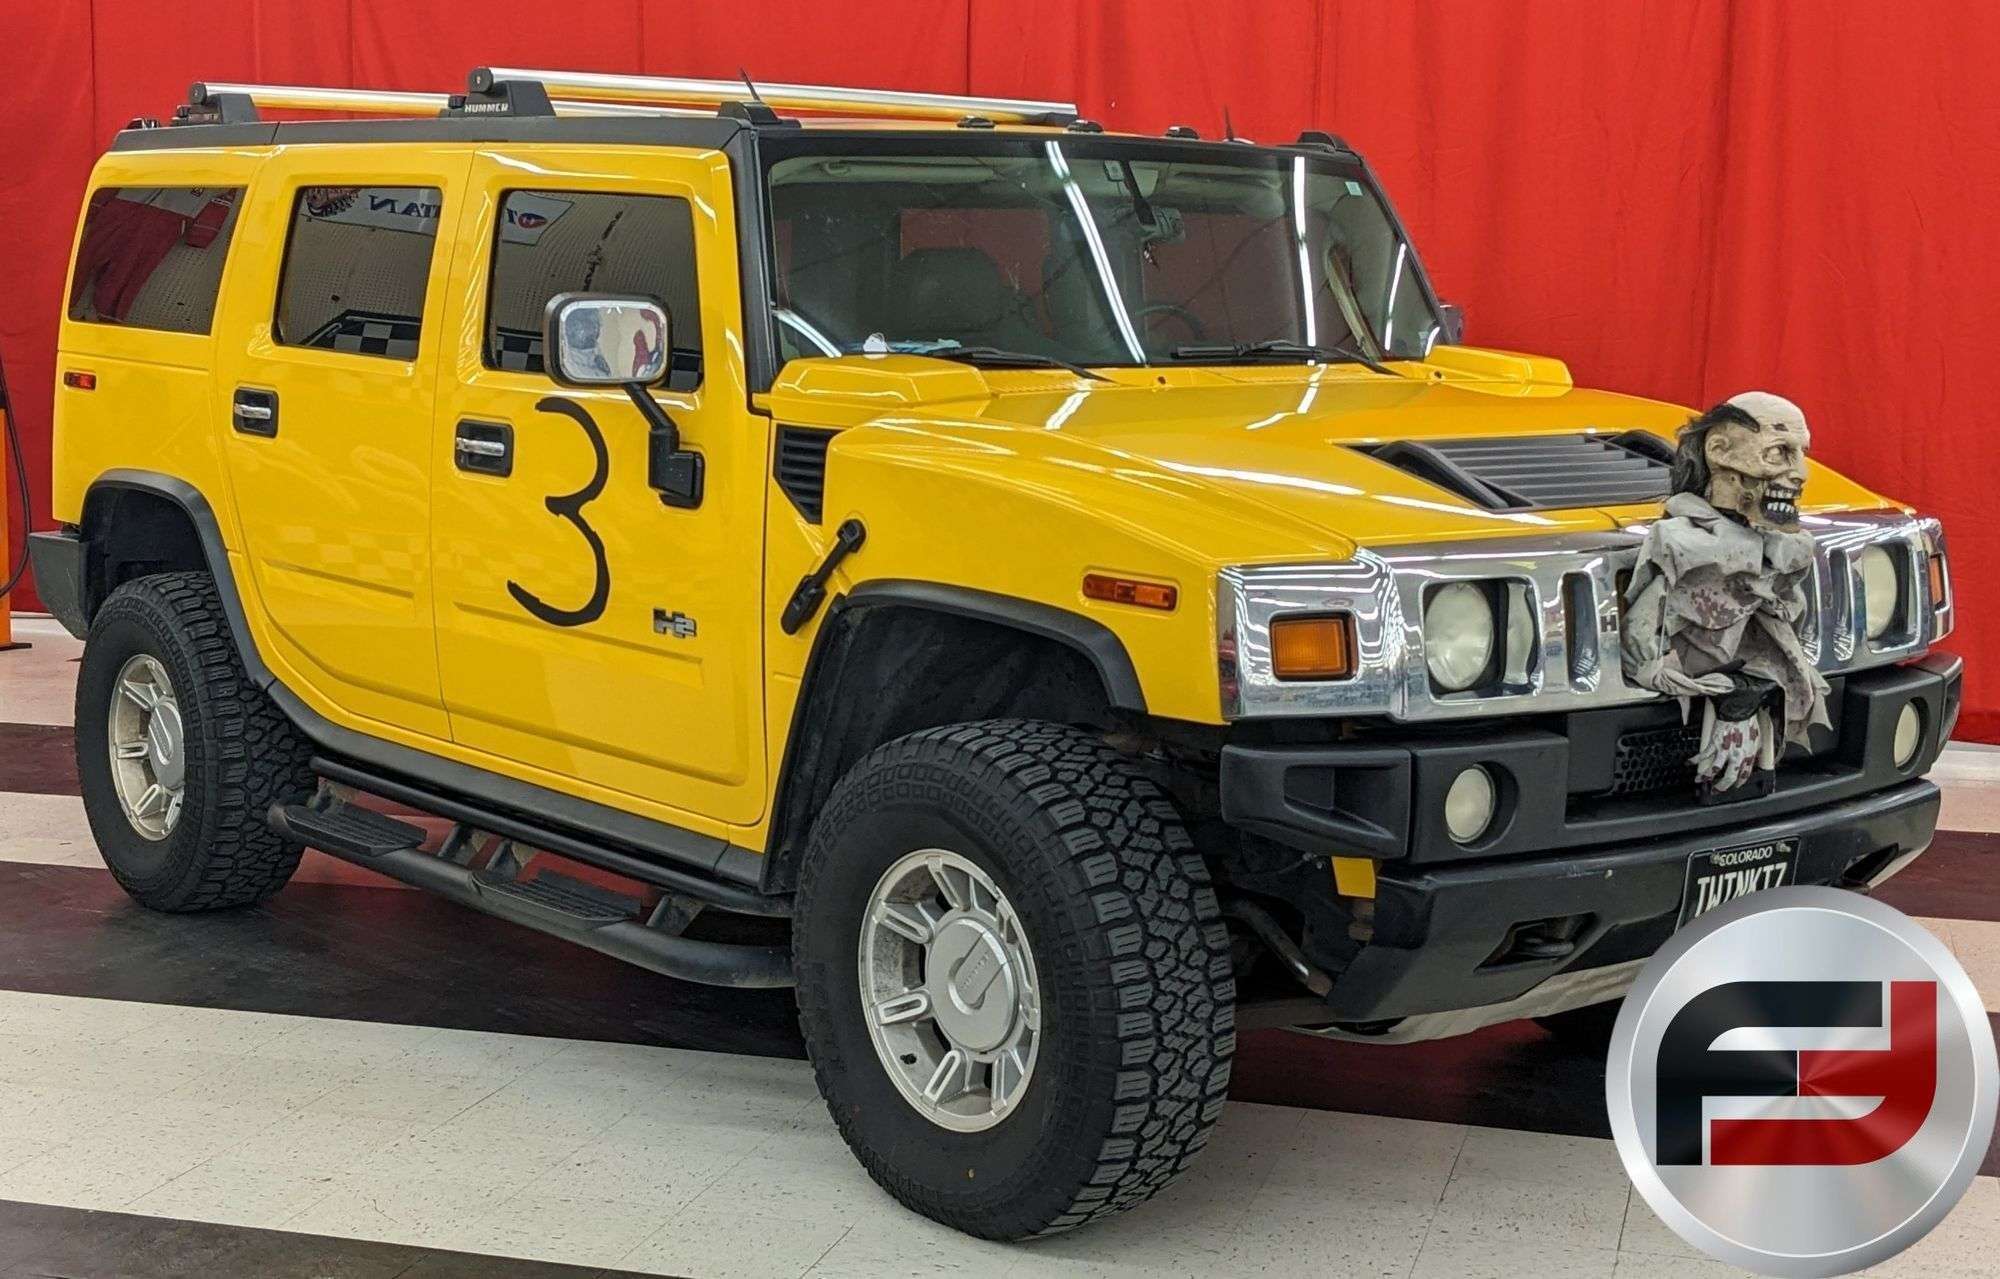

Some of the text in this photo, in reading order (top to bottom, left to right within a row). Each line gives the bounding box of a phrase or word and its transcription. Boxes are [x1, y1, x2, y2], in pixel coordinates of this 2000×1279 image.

[507, 396, 610, 627] 3
[653, 608, 697, 639] H2
[1719, 845, 1773, 867] COLORADO
